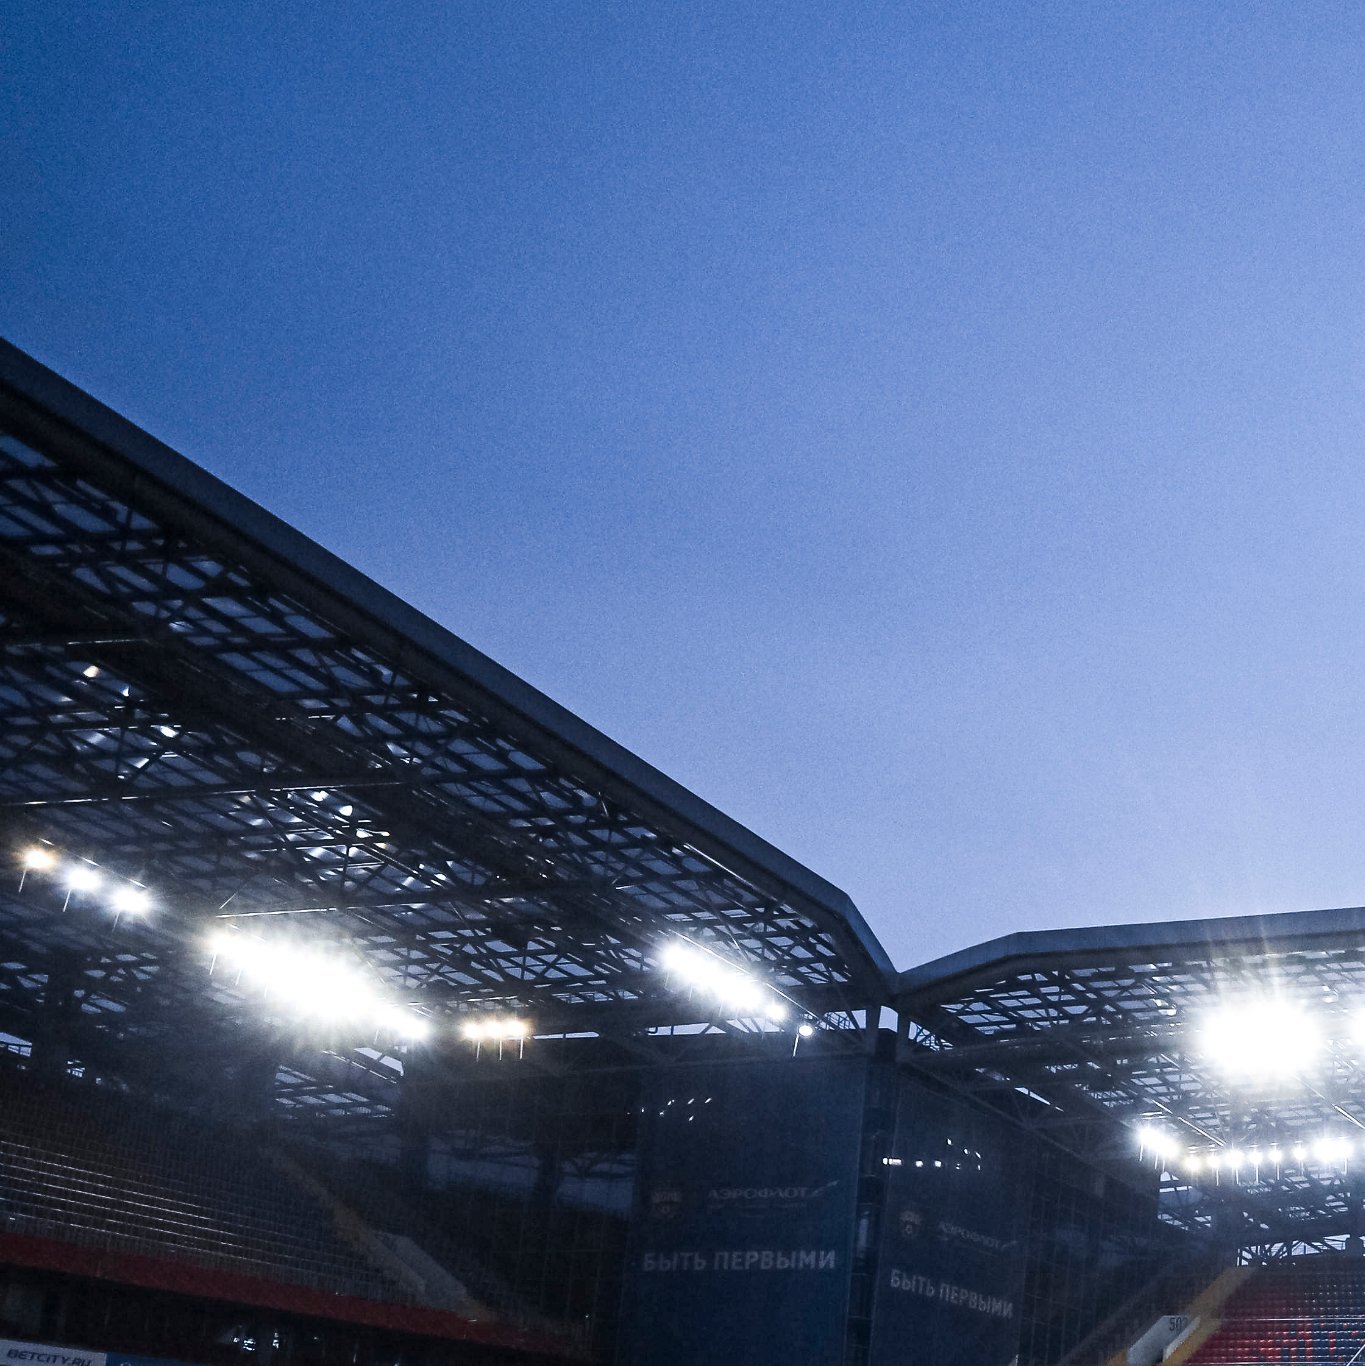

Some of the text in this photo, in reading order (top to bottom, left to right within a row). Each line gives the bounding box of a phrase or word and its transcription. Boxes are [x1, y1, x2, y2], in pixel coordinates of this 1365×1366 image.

[643, 1250, 836, 1271] БЫТЬ ПЕРВЫМИ
[890, 1269, 1014, 1319] БЫТЬ ПЕРВЫМИ
